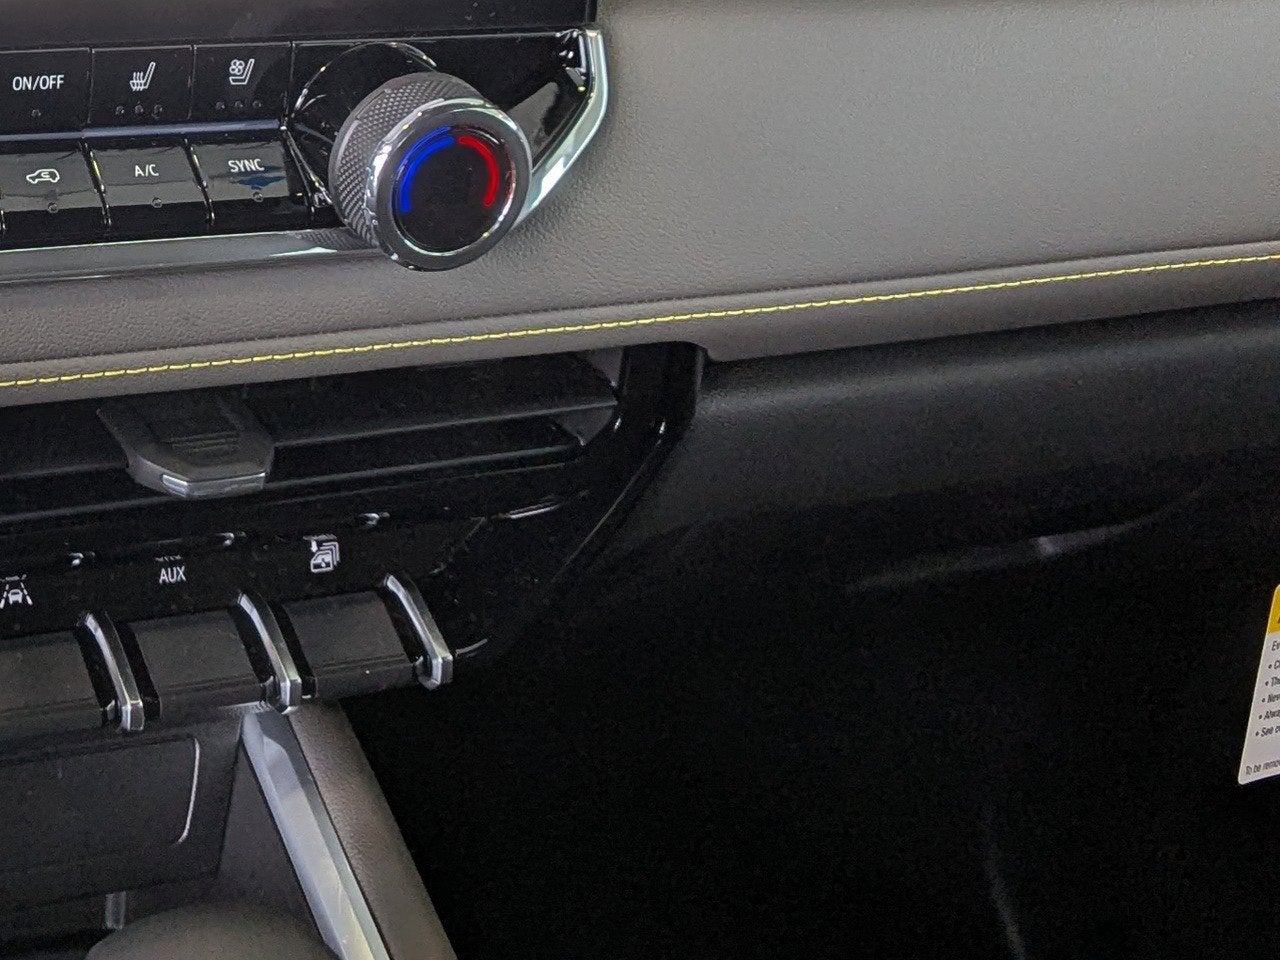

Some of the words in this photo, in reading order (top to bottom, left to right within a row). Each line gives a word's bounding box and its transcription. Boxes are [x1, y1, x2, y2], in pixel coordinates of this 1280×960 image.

[12, 74, 65, 91] ON/OFF
[134, 163, 160, 178] A/C
[228, 158, 265, 173] SYNC
[159, 565, 187, 584] AUX
